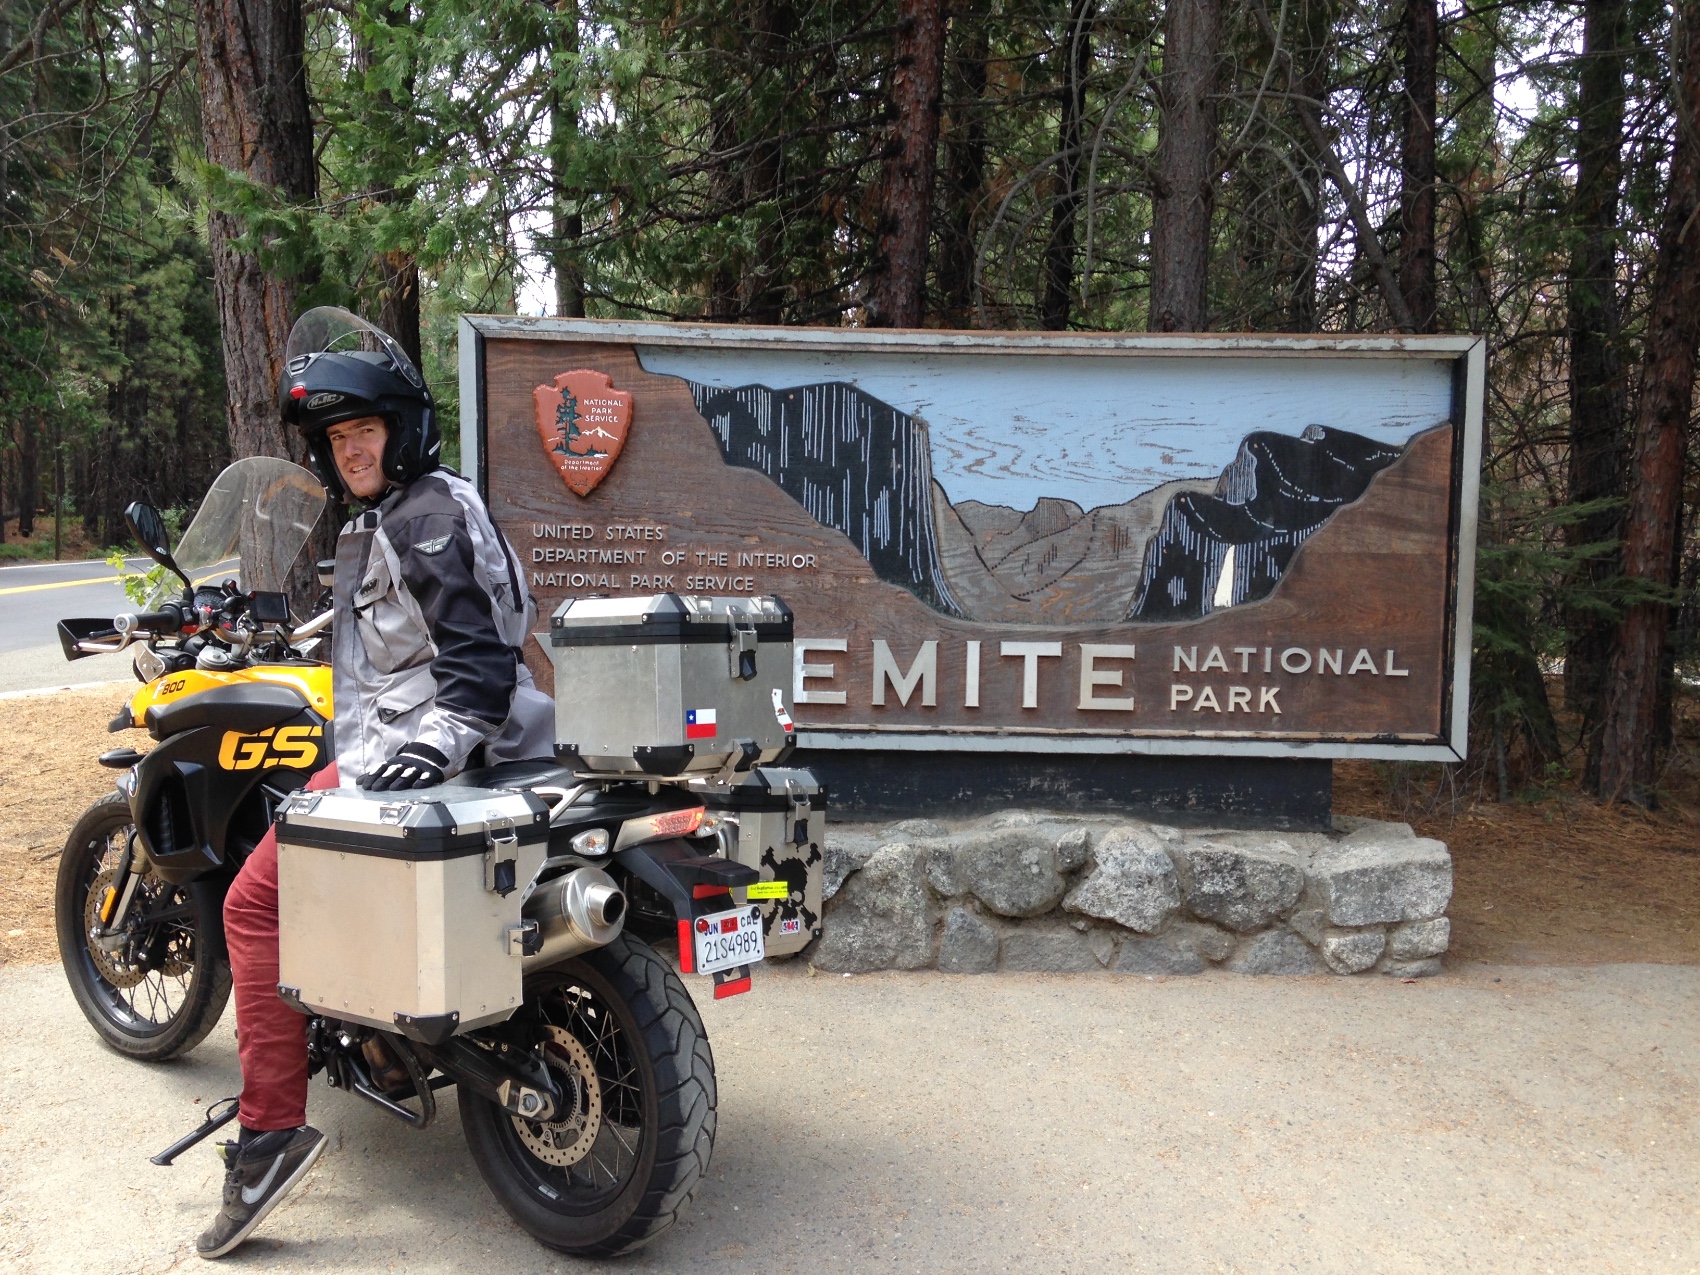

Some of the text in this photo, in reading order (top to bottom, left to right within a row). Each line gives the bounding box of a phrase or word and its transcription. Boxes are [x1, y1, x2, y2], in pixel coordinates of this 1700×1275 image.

[583, 399, 623, 407] NATIONAL
[584, 415, 619, 423] SERVICE
[532, 523, 664, 541] UNITED STATES
[532, 547, 816, 569] DEPARTMENT OF THE INTERIOR
[532, 572, 754, 591] NATIONAL PARK SERVICE
[1172, 645, 1409, 677] NATIONAL
[151, 678, 186, 700] F800
[1170, 684, 1282, 714] PARK
[218, 725, 323, 771] GS
[704, 922, 718, 936] JUN
[704, 930, 758, 963] 21S4989
